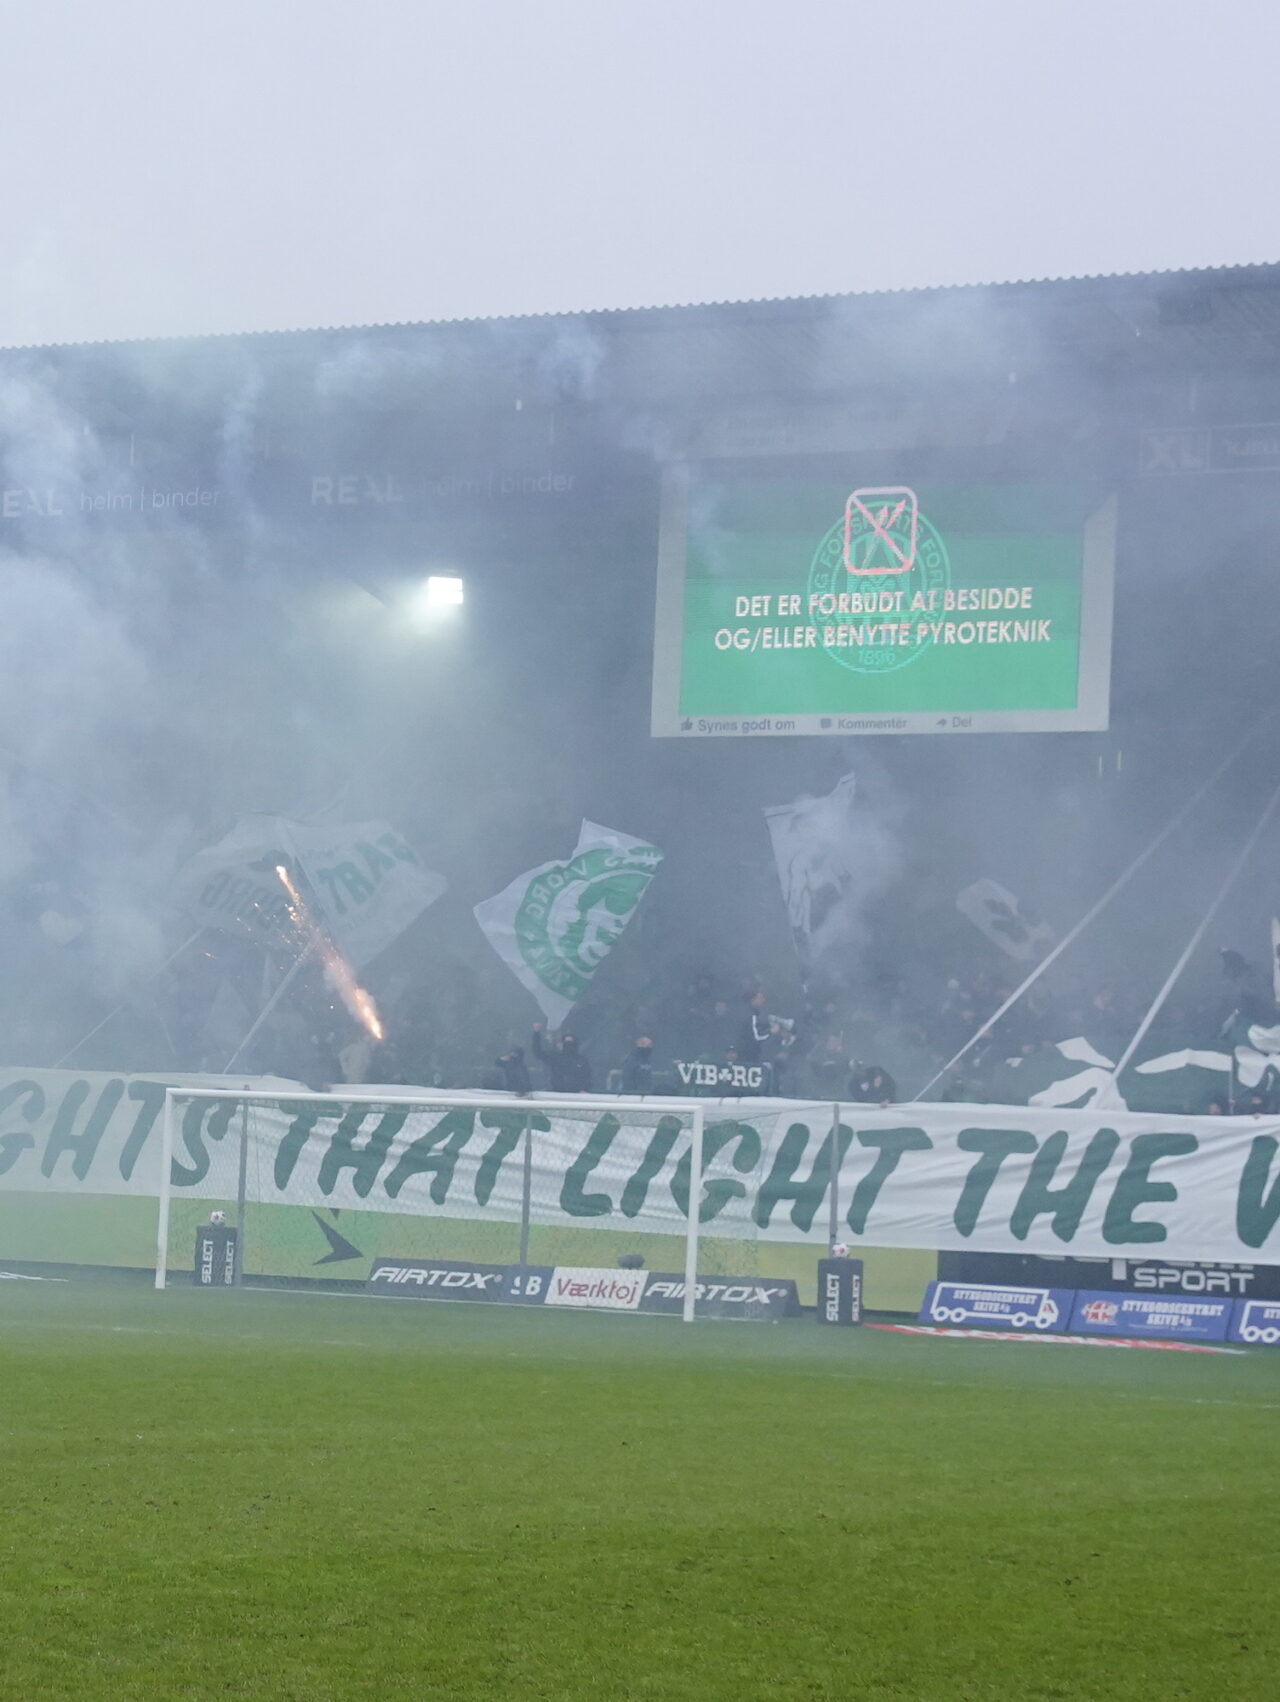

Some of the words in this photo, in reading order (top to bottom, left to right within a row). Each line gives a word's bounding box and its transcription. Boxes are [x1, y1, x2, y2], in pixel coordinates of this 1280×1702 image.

[151, 487, 221, 509] binder
[311, 473, 404, 505] REAL
[735, 595, 770, 617] DET
[778, 594, 802, 616] ER
[809, 590, 905, 616] FORBUDT
[910, 590, 937, 613] AT
[943, 587, 1033, 612] BESIDDE
[714, 625, 817, 653] OG/ELLER
[823, 623, 909, 648] BENYTTE
[915, 620, 1051, 646] PYROTEKNIK
[698, 718, 738, 734] Synes
[741, 717, 772, 735] godt
[774, 719, 797, 731] om
[837, 716, 908, 731] Kommenter
[951, 715, 973, 729] Del
[275, 1100, 551, 1207] THAT
[560, 1111, 934, 1235] LIGHT
[953, 1126, 1199, 1245] THE
[201, 1239, 214, 1284] SELECT
[224, 1240, 235, 1285] SELECT
[370, 1266, 495, 1290] AIRTOX
[1133, 1267, 1255, 1294] SPORT
[644, 1281, 779, 1305] AIRTOX
[825, 1272, 840, 1322] SELECT
[1147, 1313, 1180, 1327] SKIVE
